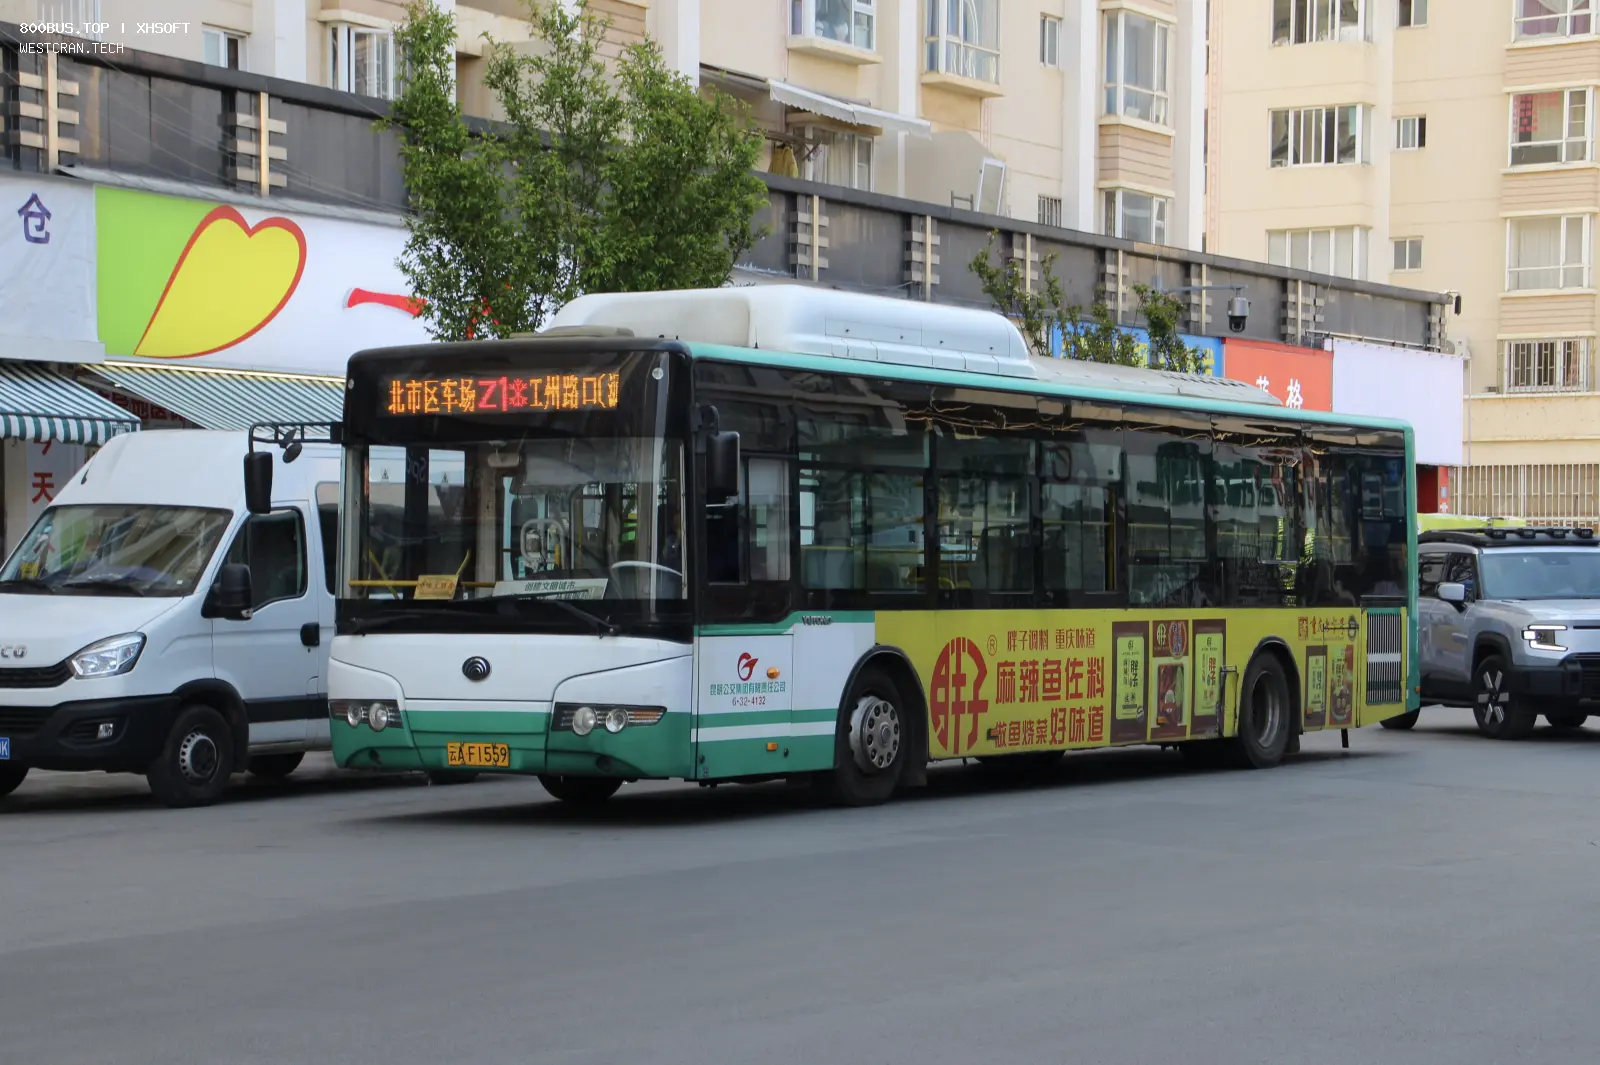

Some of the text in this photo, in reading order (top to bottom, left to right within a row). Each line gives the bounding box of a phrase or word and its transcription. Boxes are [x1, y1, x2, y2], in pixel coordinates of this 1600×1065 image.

[17, 192, 52, 244] 仓
[388, 378, 476, 414] 北市区车场
[477, 376, 508, 411] Z1
[524, 580, 576, 592] 创建文明城市
[1007, 628, 1096, 652] 胖子调料 重庆味道
[0, 643, 27, 659] CO
[709, 681, 786, 696] 昆明公交集团有限责任公司
[995, 656, 1105, 705] 麻辣鱼佐料
[732, 695, 766, 707] 6-32-4132
